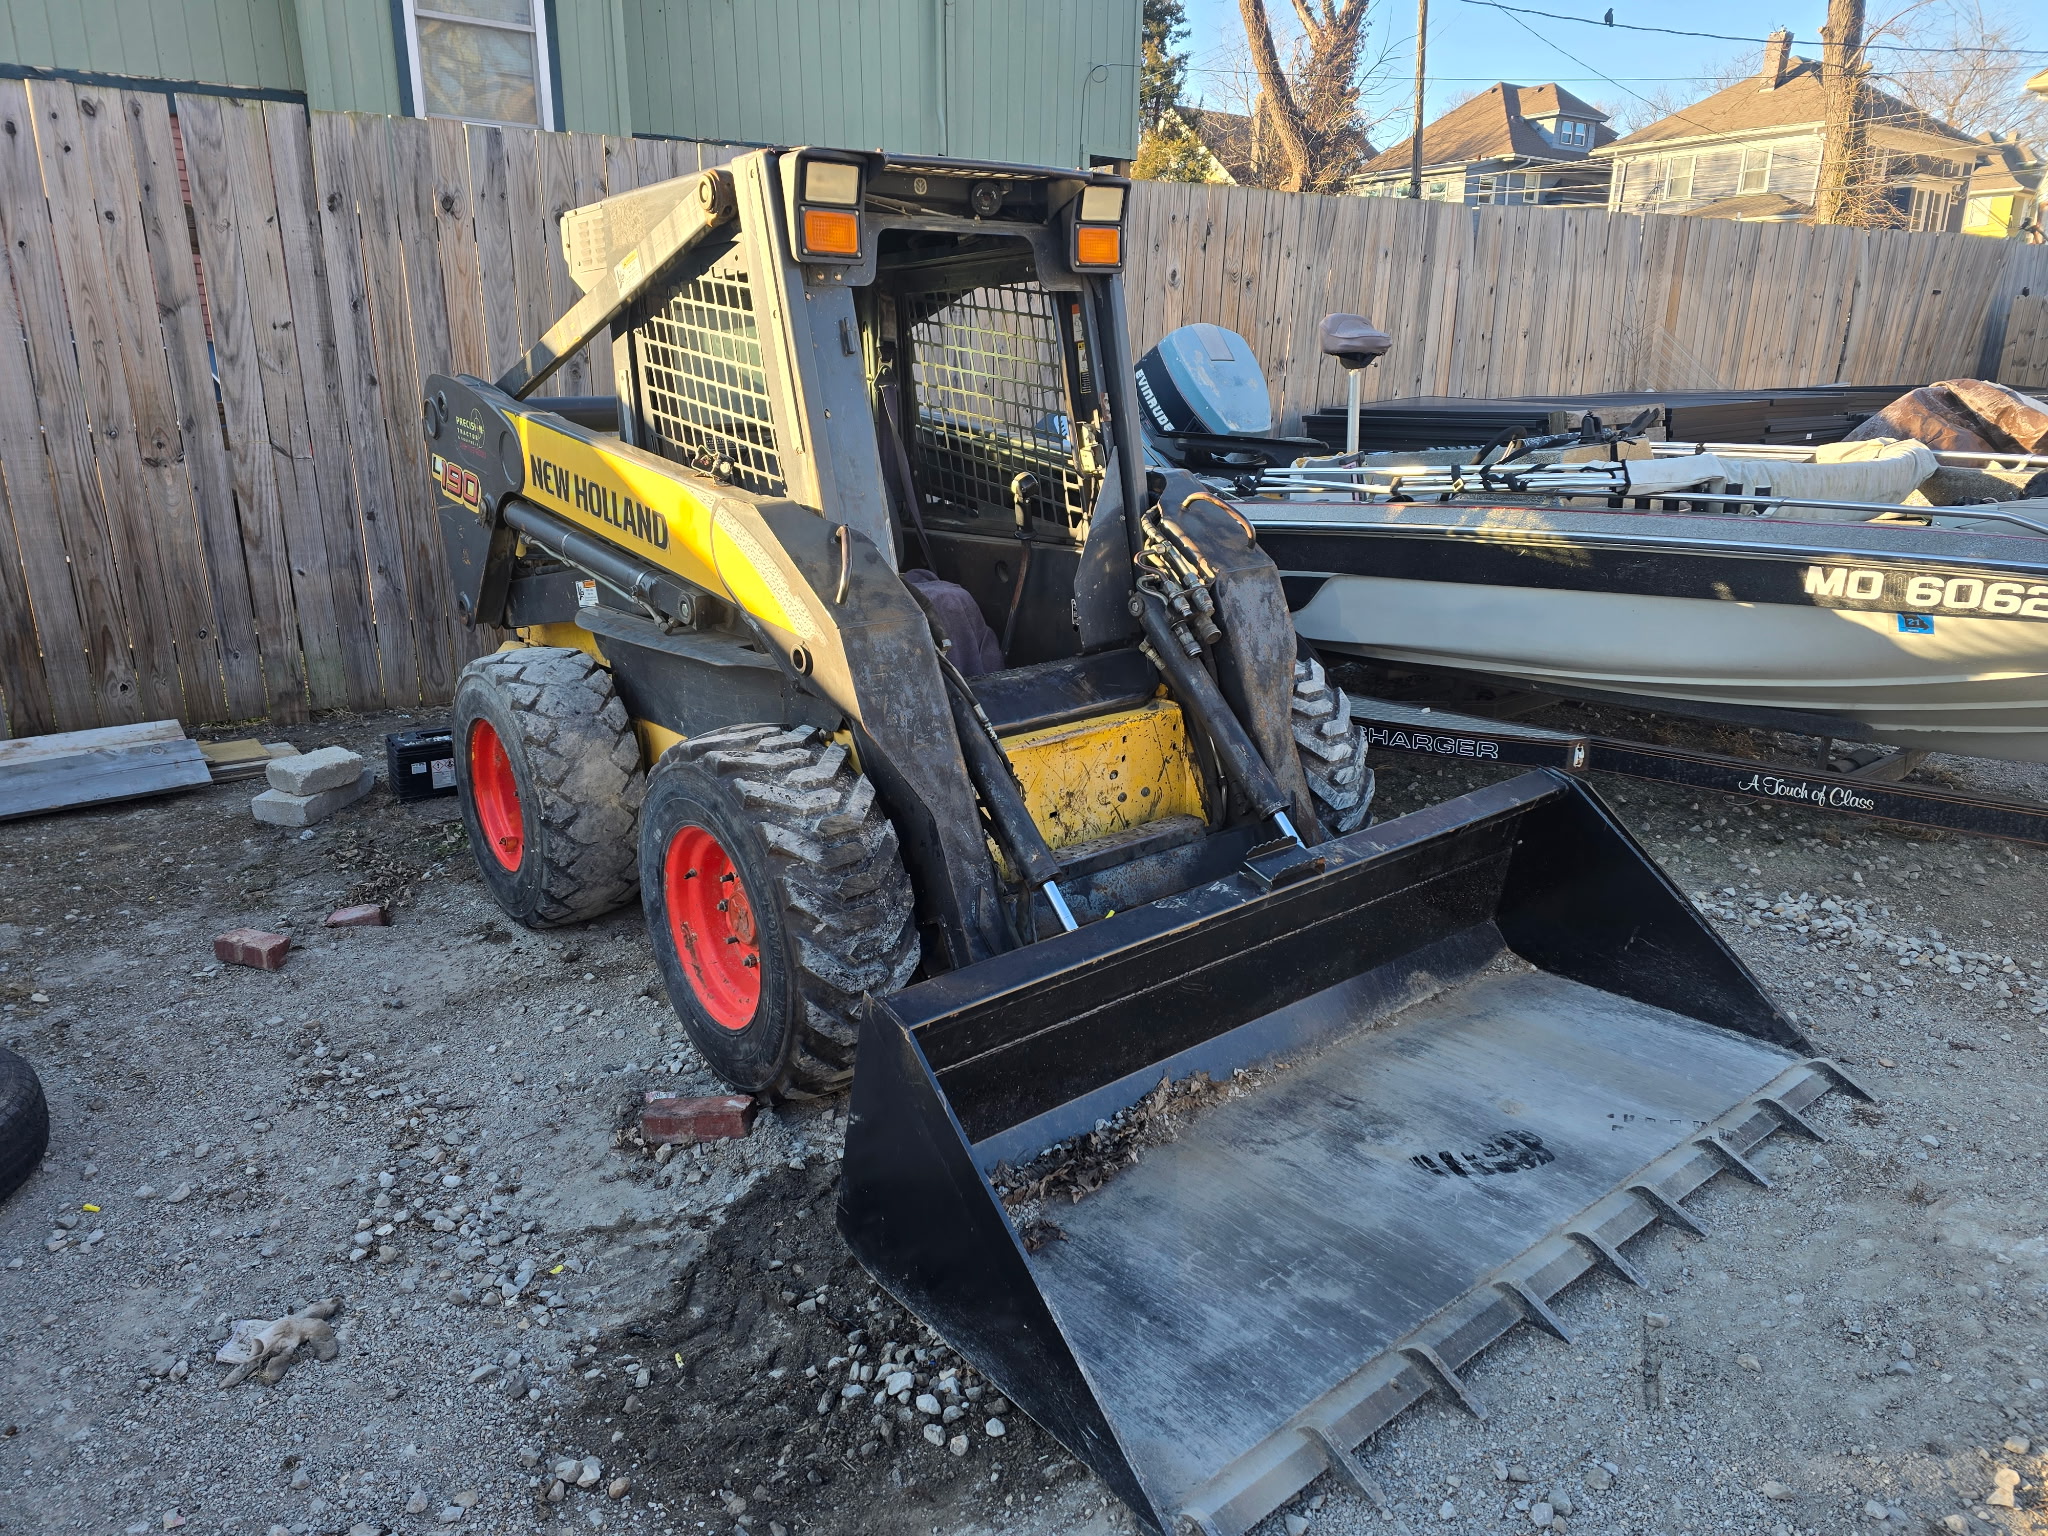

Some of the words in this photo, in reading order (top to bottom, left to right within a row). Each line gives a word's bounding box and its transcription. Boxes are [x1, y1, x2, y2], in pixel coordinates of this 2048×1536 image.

[1135, 368, 1175, 432] EVINRUDE
[530, 453, 570, 503] NEW
[573, 473, 669, 550] HOLLAND
[1804, 565, 1885, 600] MO
[1905, 576, 2048, 618] 6062
[1361, 726, 1499, 759] HARGER
[1738, 774, 1760, 793] A
[1762, 776, 1809, 796] Touch
[1811, 784, 1827, 807] of
[1829, 786, 1875, 811] Class
